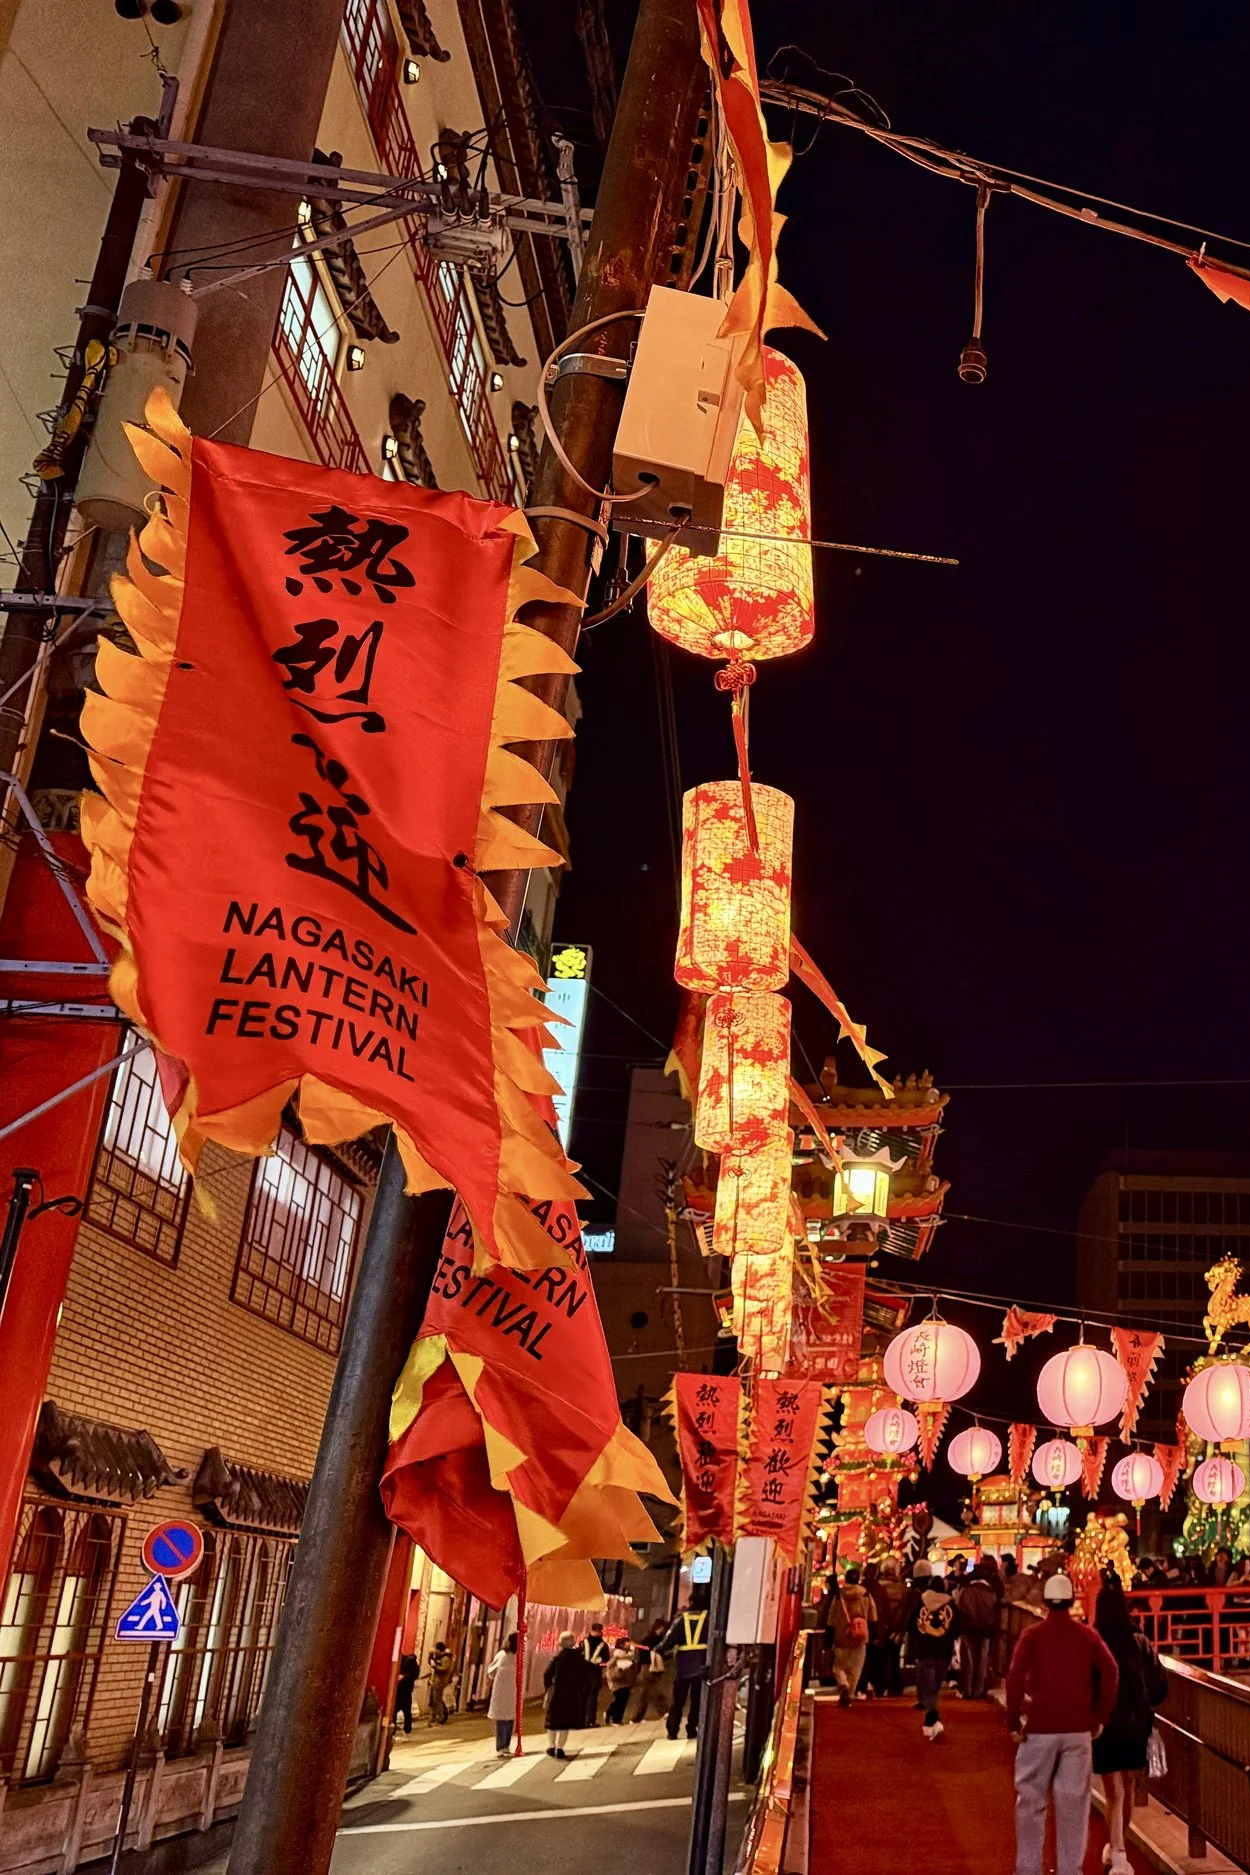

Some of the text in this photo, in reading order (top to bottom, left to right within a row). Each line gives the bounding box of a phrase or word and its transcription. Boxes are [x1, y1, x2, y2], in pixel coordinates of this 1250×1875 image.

[219, 948, 419, 1042] LANTERN
[222, 900, 429, 1009] NAGASAKI
[205, 998, 415, 1083] FESTIVAL
[432, 1254, 553, 1361] ESTIVAL
